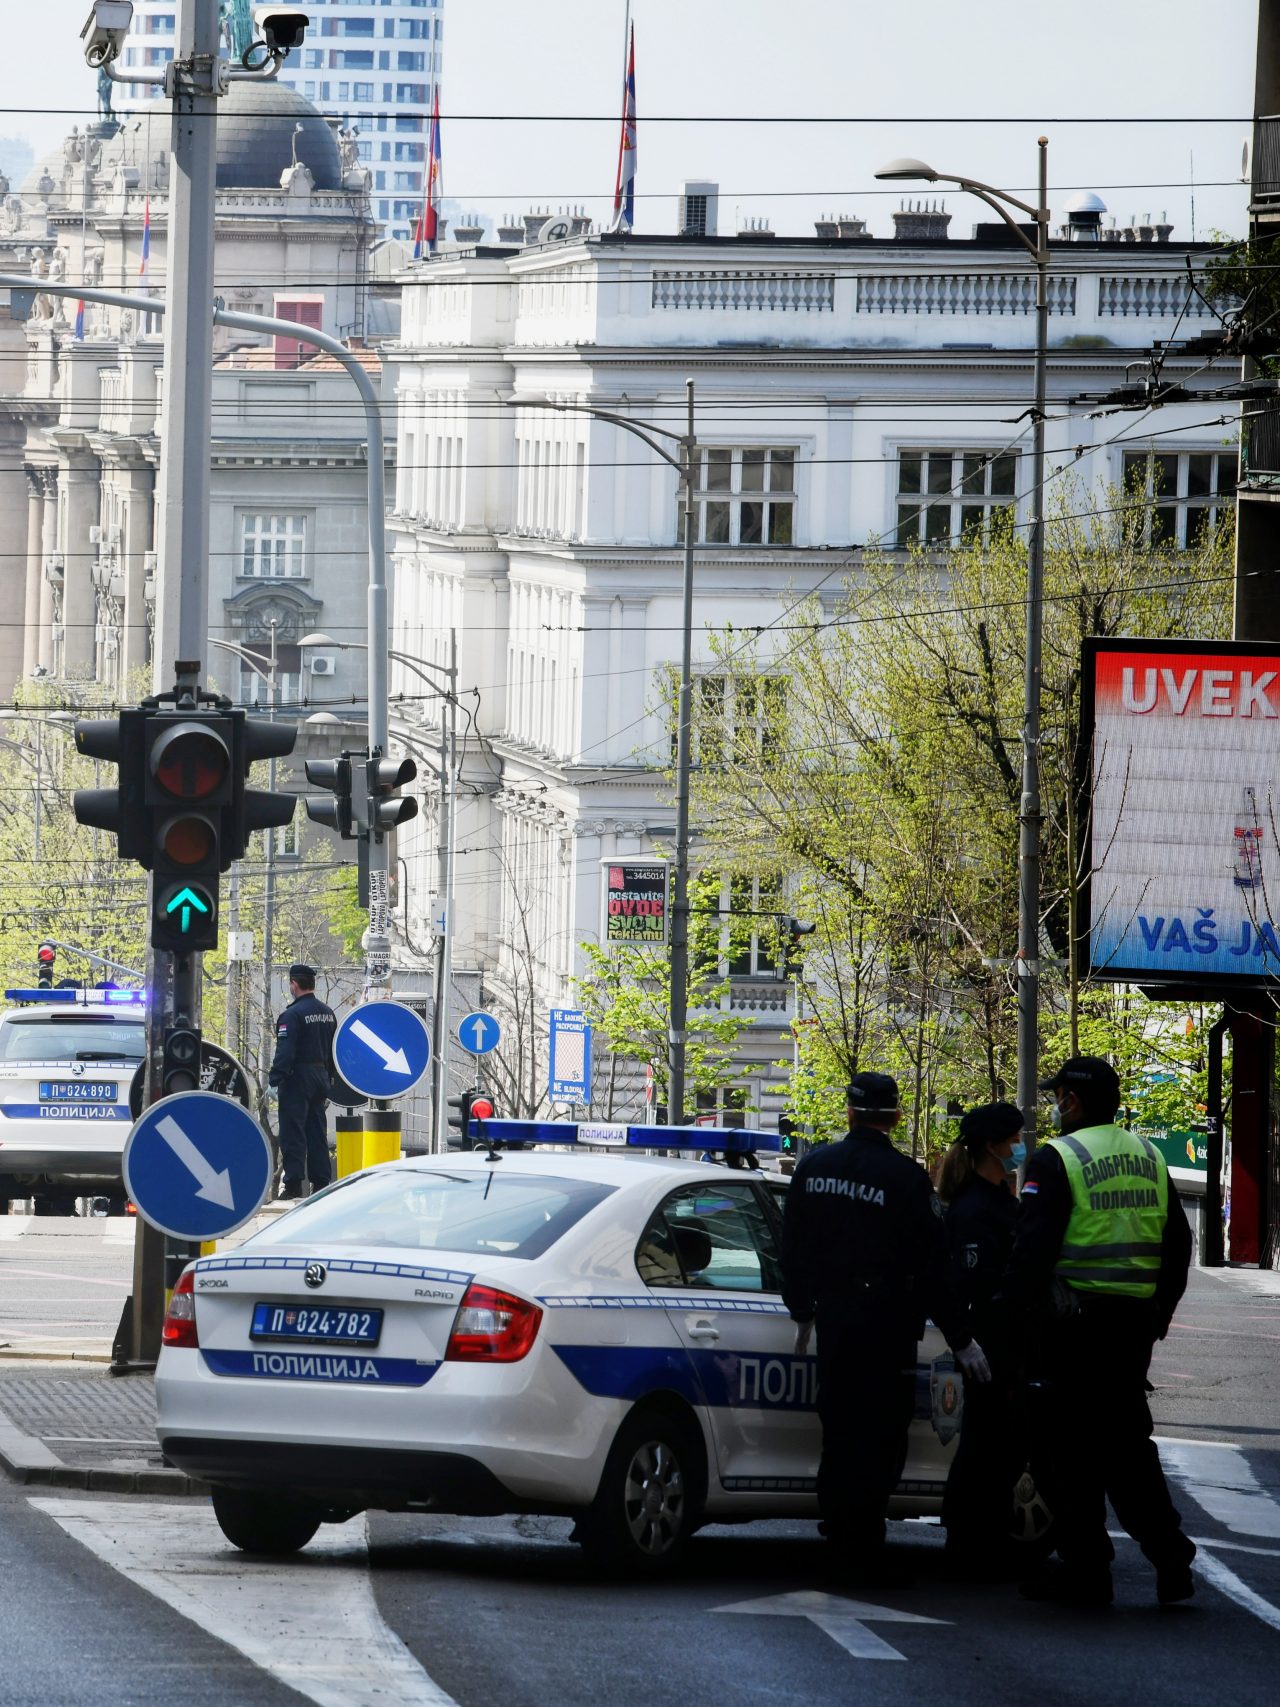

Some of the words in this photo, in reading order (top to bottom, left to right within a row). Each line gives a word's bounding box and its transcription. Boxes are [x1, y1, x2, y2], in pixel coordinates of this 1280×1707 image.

[1122, 667, 1278, 719] UVEK
[633, 872, 664, 880] 3445014
[609, 890, 664, 901] postavite
[608, 900, 664, 916] OVDE
[608, 928, 664, 940] reklamu
[1137, 907, 1218, 954] VAŠ
[1229, 921, 1280, 957] JA
[52, 1085, 59, 1096] П
[553, 1081, 562, 1092] NE
[40, 1106, 116, 1119] ПОЛИЦИЈА
[579, 1128, 624, 1140] ПОЛИЦИЈА
[806, 1177, 885, 1207] ПОЛИЦИЈА
[1089, 1187, 1159, 1211] ПОЛИЦИЈА
[414, 1288, 454, 1300] RAPID
[271, 1309, 285, 1331] П
[252, 1353, 380, 1379] ПОЛИЦИЈА
